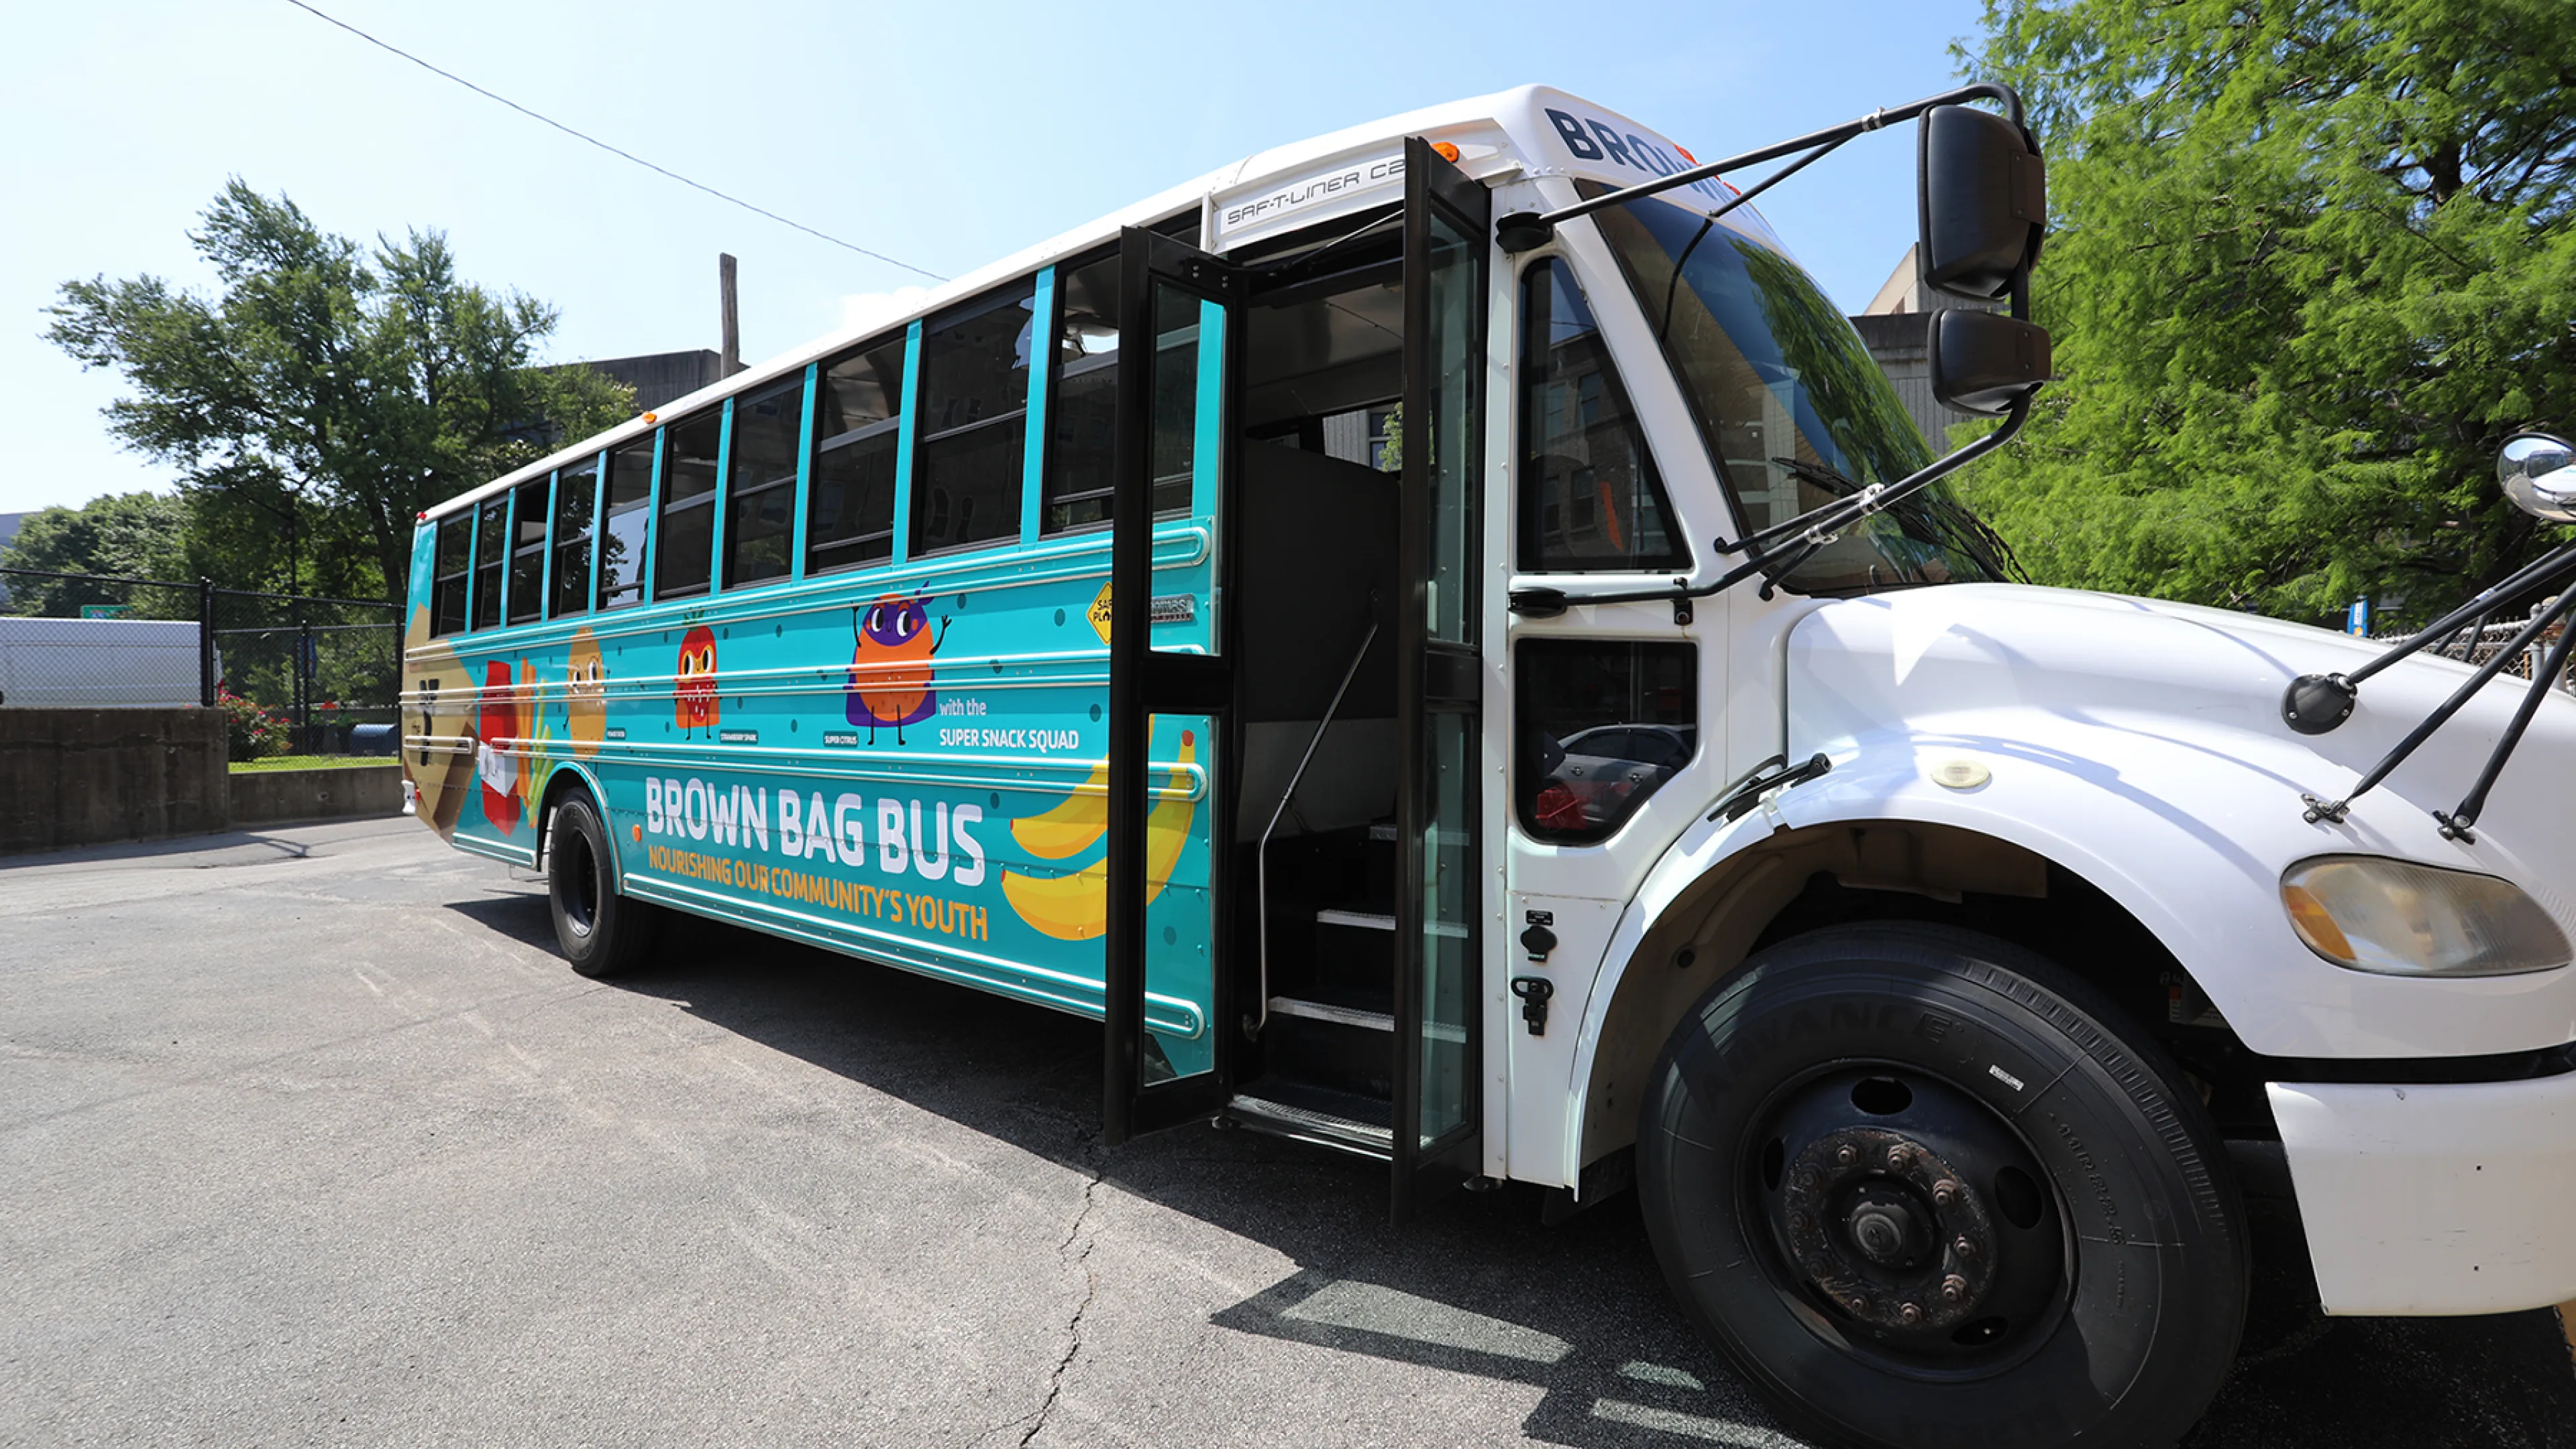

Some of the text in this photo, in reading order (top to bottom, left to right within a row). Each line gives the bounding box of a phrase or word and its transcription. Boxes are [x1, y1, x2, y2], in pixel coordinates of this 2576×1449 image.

[939, 698, 987, 716] with the
[940, 729, 1079, 753] SUPER SNACK SQUAD
[646, 777, 985, 886] BROWN BAG BUS
[649, 845, 988, 941] NOURISHING OUR COMMUNITY'S YOUTH
